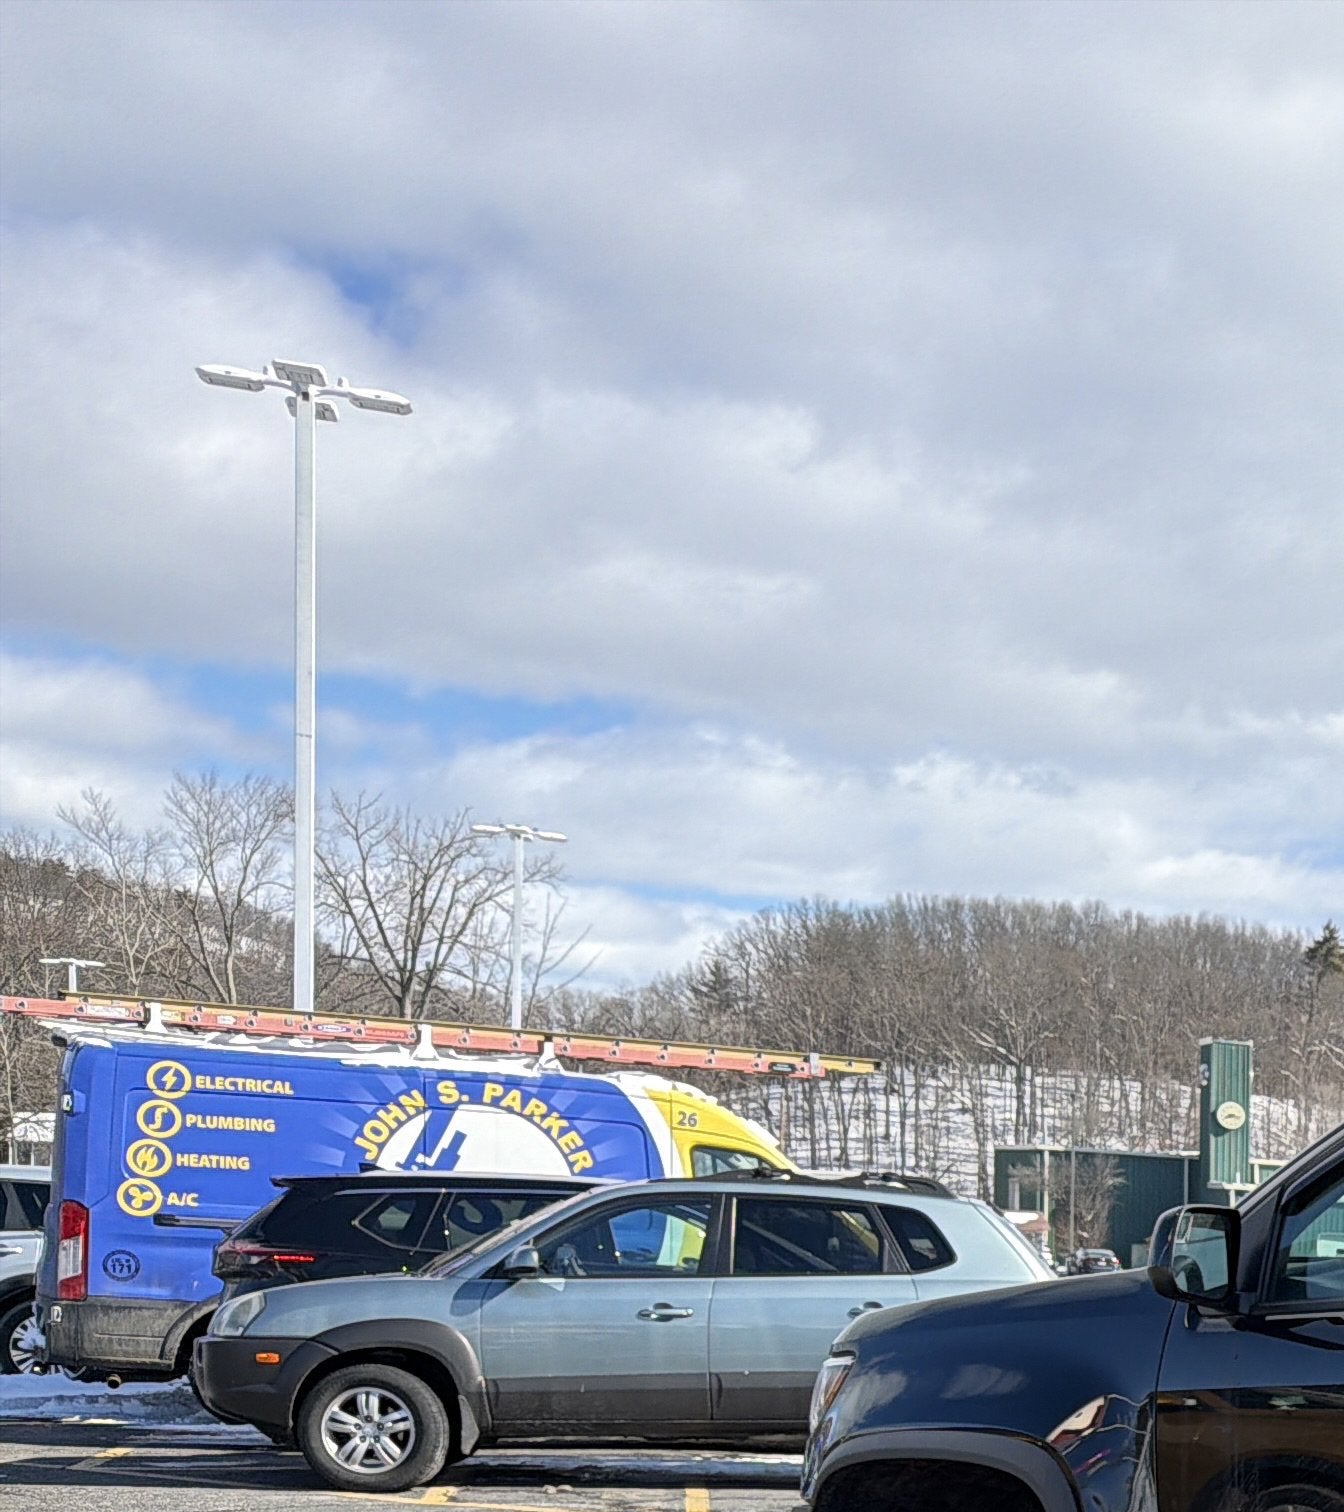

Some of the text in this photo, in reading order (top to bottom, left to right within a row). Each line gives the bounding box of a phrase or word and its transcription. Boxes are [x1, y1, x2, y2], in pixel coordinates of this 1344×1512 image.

[195, 1075, 294, 1095] ELECTRICAL
[185, 1114, 276, 1133] PLUMBING
[354, 1081, 593, 1174] JOHN S. PARKER
[676, 1110, 698, 1128] 26
[176, 1153, 250, 1170] HEATING
[167, 1192, 199, 1207] A/C
[110, 1263, 132, 1274] 171
